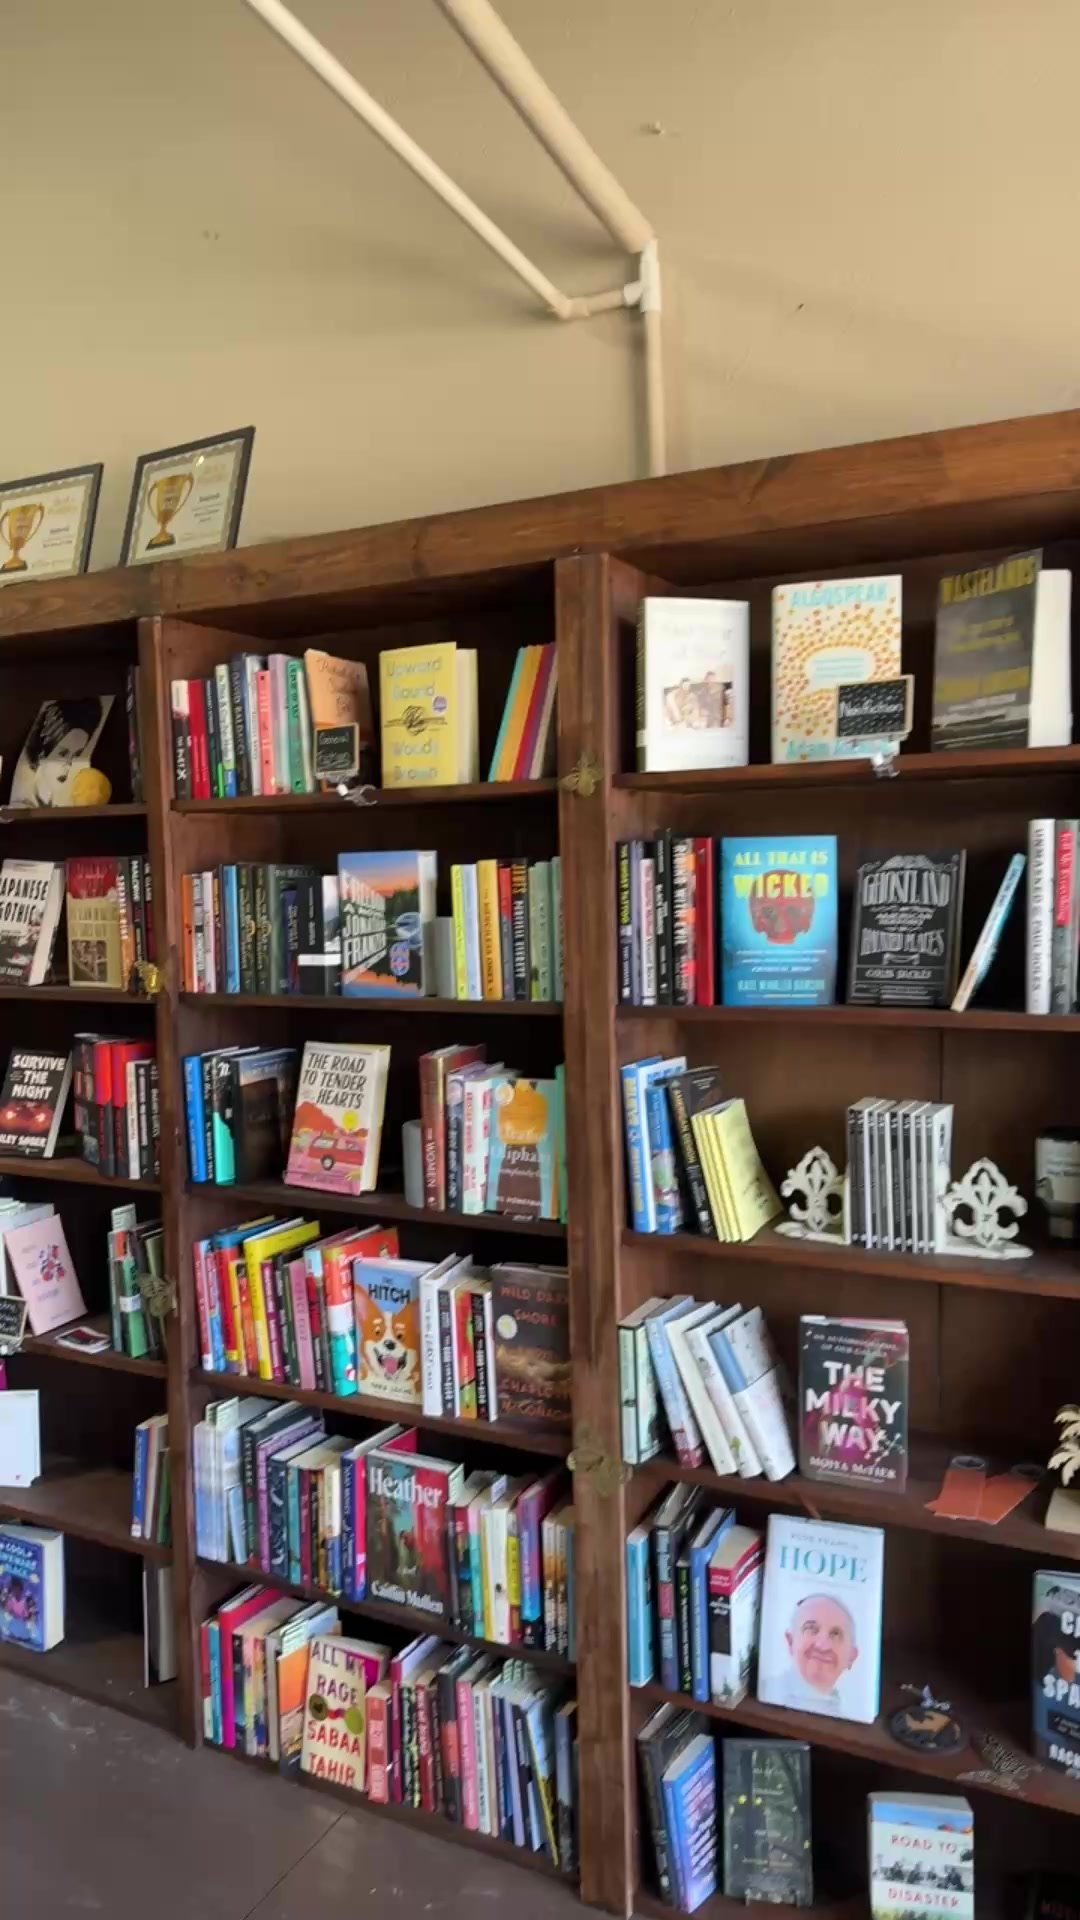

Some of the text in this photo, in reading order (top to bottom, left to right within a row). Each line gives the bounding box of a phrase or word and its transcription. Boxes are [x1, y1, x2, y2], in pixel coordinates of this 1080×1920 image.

[734, 851, 829, 867] ALL THAT IS
[1031, 828, 1044, 904] UNMASKED
[733, 873, 829, 899] WICKED
[12, 1054, 67, 1071] SURVIVE
[308, 1052, 366, 1074] THE ROAD
[23, 1070, 49, 1085] THE
[302, 1069, 367, 1092] TO TENDER
[11, 1083, 53, 1100] NIGHT
[315, 1088, 364, 1109] HEARTS
[425, 1142, 437, 1188] WOMEN
[368, 1283, 410, 1304] HITCH
[500, 1285, 531, 1300] WILD
[822, 1360, 886, 1393] THE
[805, 1387, 903, 1426] MILKY
[819, 1420, 887, 1453] WAY
[369, 1466, 443, 1509] Heather
[779, 1545, 869, 1583] HOPE
[311, 1640, 366, 1681] ALL MY
[317, 1674, 358, 1706] RAGE
[308, 1719, 361, 1757] SABAA
[309, 1751, 357, 1787] TAHIR
[891, 1834, 957, 1855] ROAD TO
[888, 1887, 960, 1908] DISASTER
